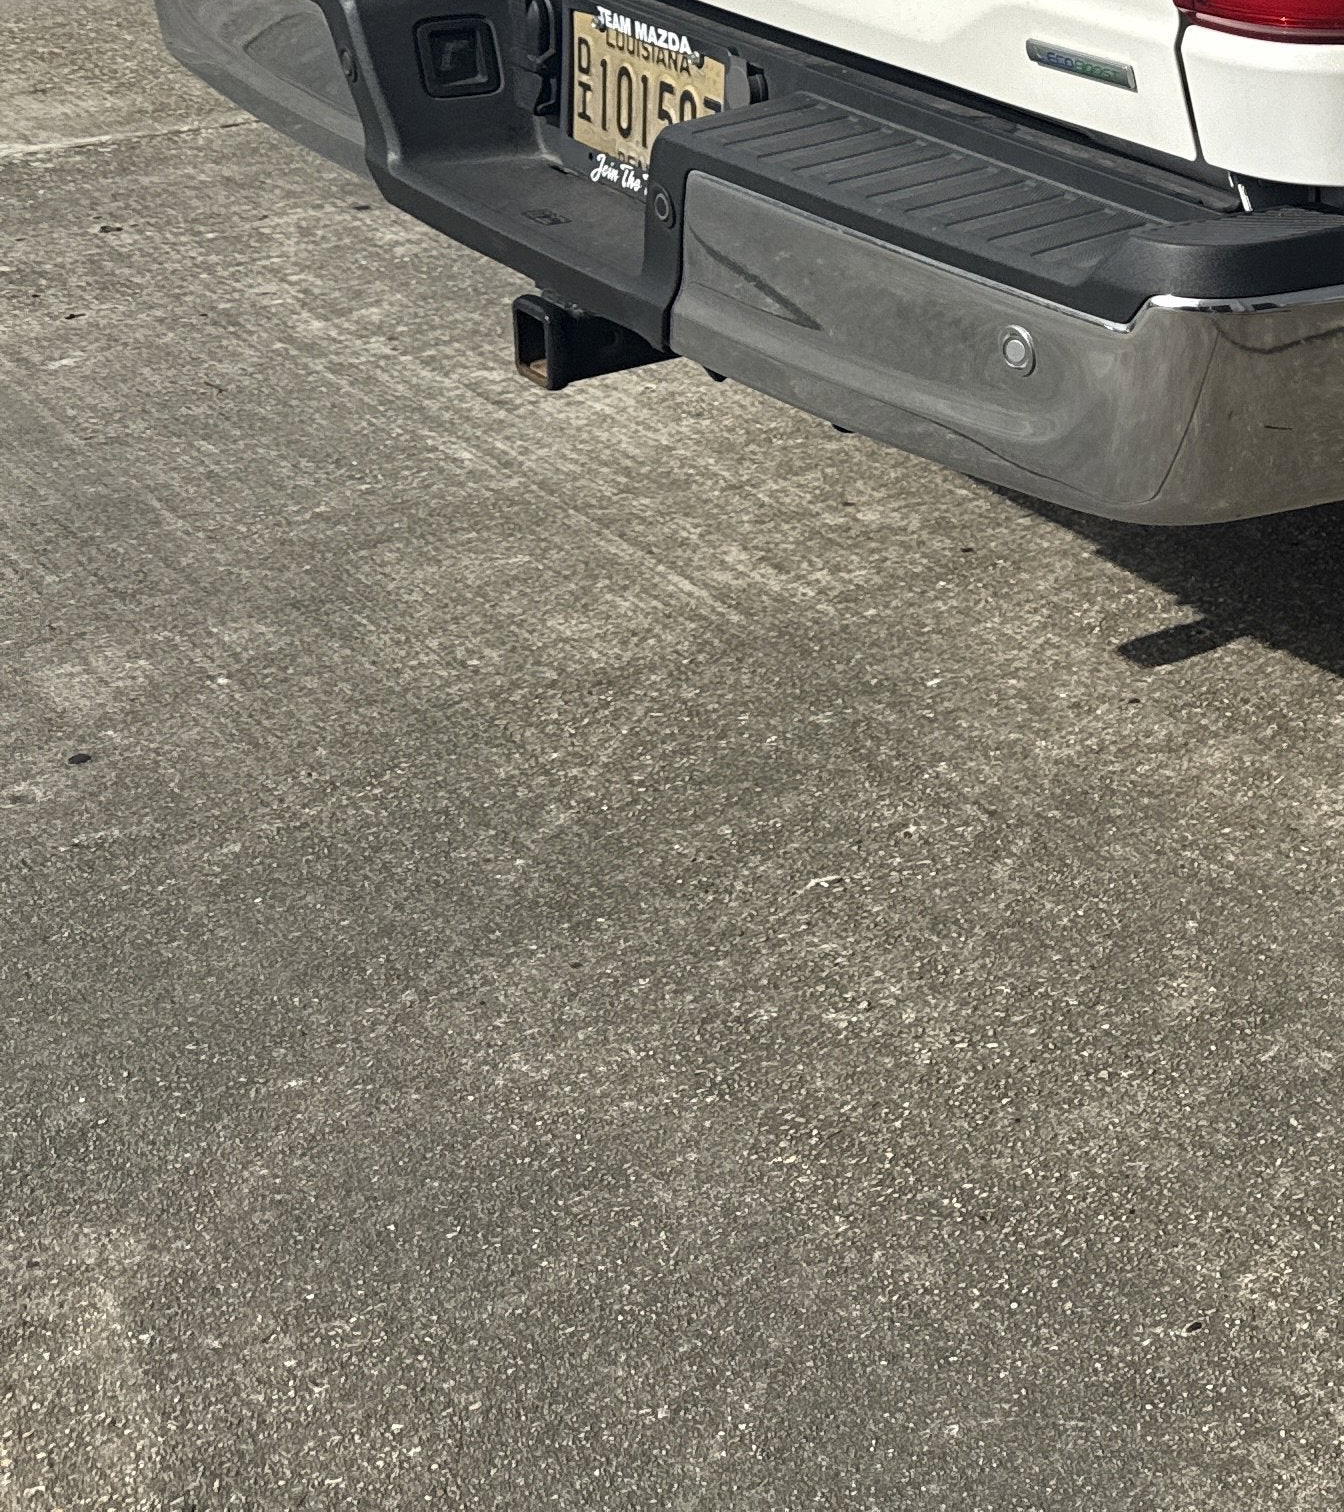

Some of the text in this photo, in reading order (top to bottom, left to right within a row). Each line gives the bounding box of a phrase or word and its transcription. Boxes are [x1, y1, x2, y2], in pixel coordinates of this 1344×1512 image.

[597, 5, 693, 56] TEAM MAZDA
[605, 28, 692, 77] LOUISIANA
[600, 58, 724, 150] 1015
[590, 153, 619, 183] Join
[619, 163, 642, 192] The
